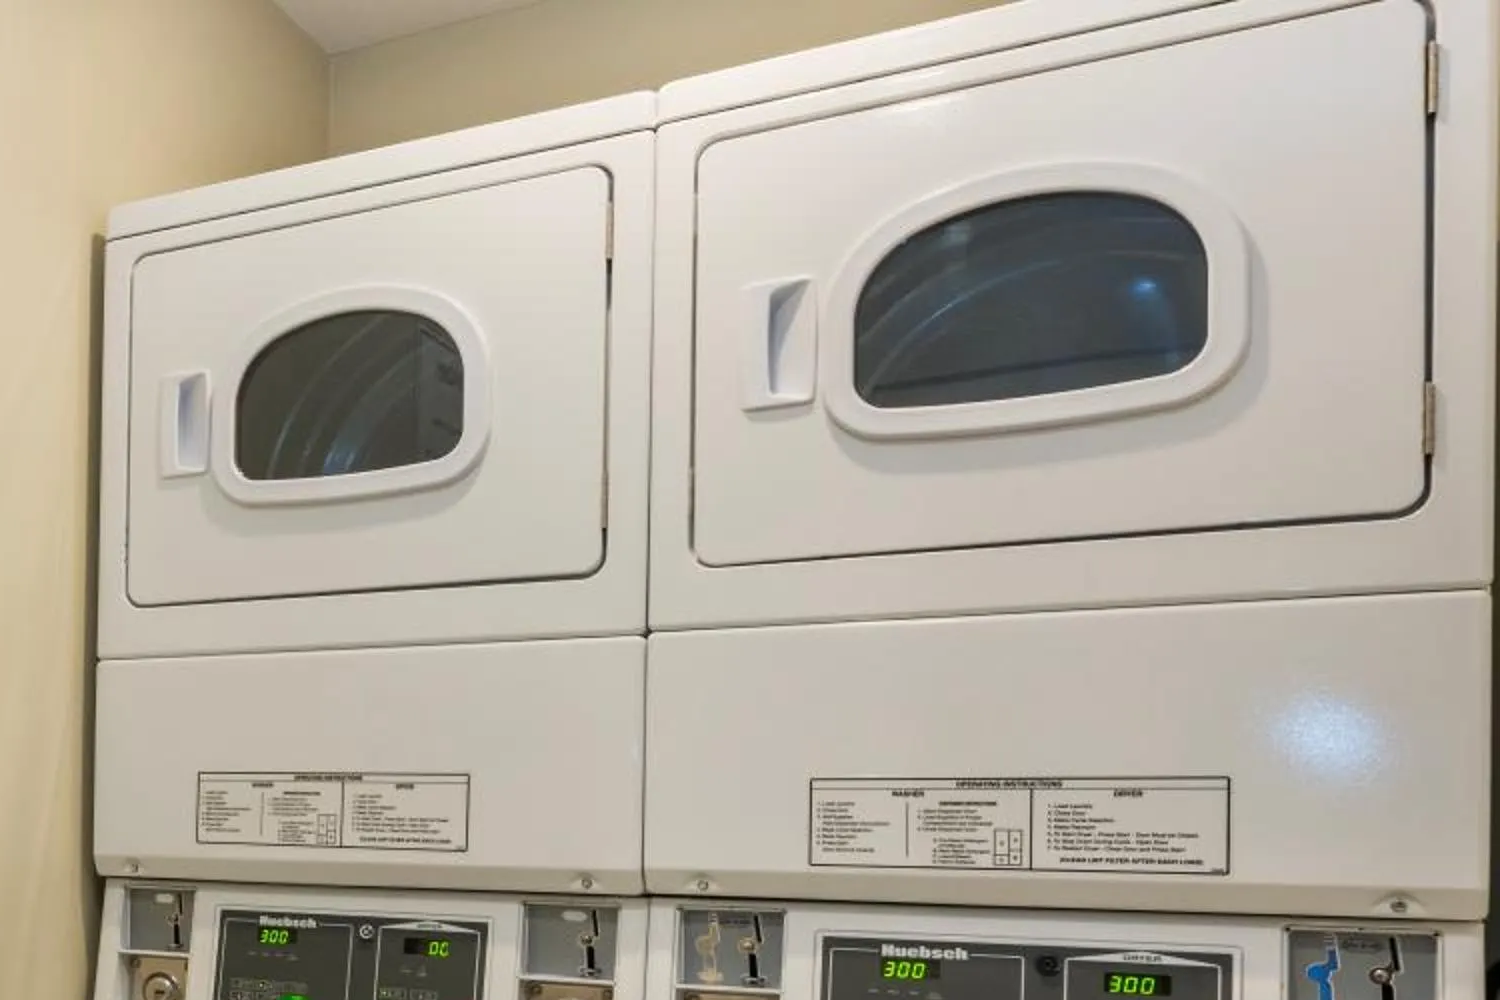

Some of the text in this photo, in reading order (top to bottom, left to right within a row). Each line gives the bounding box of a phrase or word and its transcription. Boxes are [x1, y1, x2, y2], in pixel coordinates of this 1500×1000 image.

[260, 929, 289, 944] 300
[881, 943, 968, 960] Huebsch
[884, 961, 925, 979] 300
[1109, 975, 1155, 995] 300
